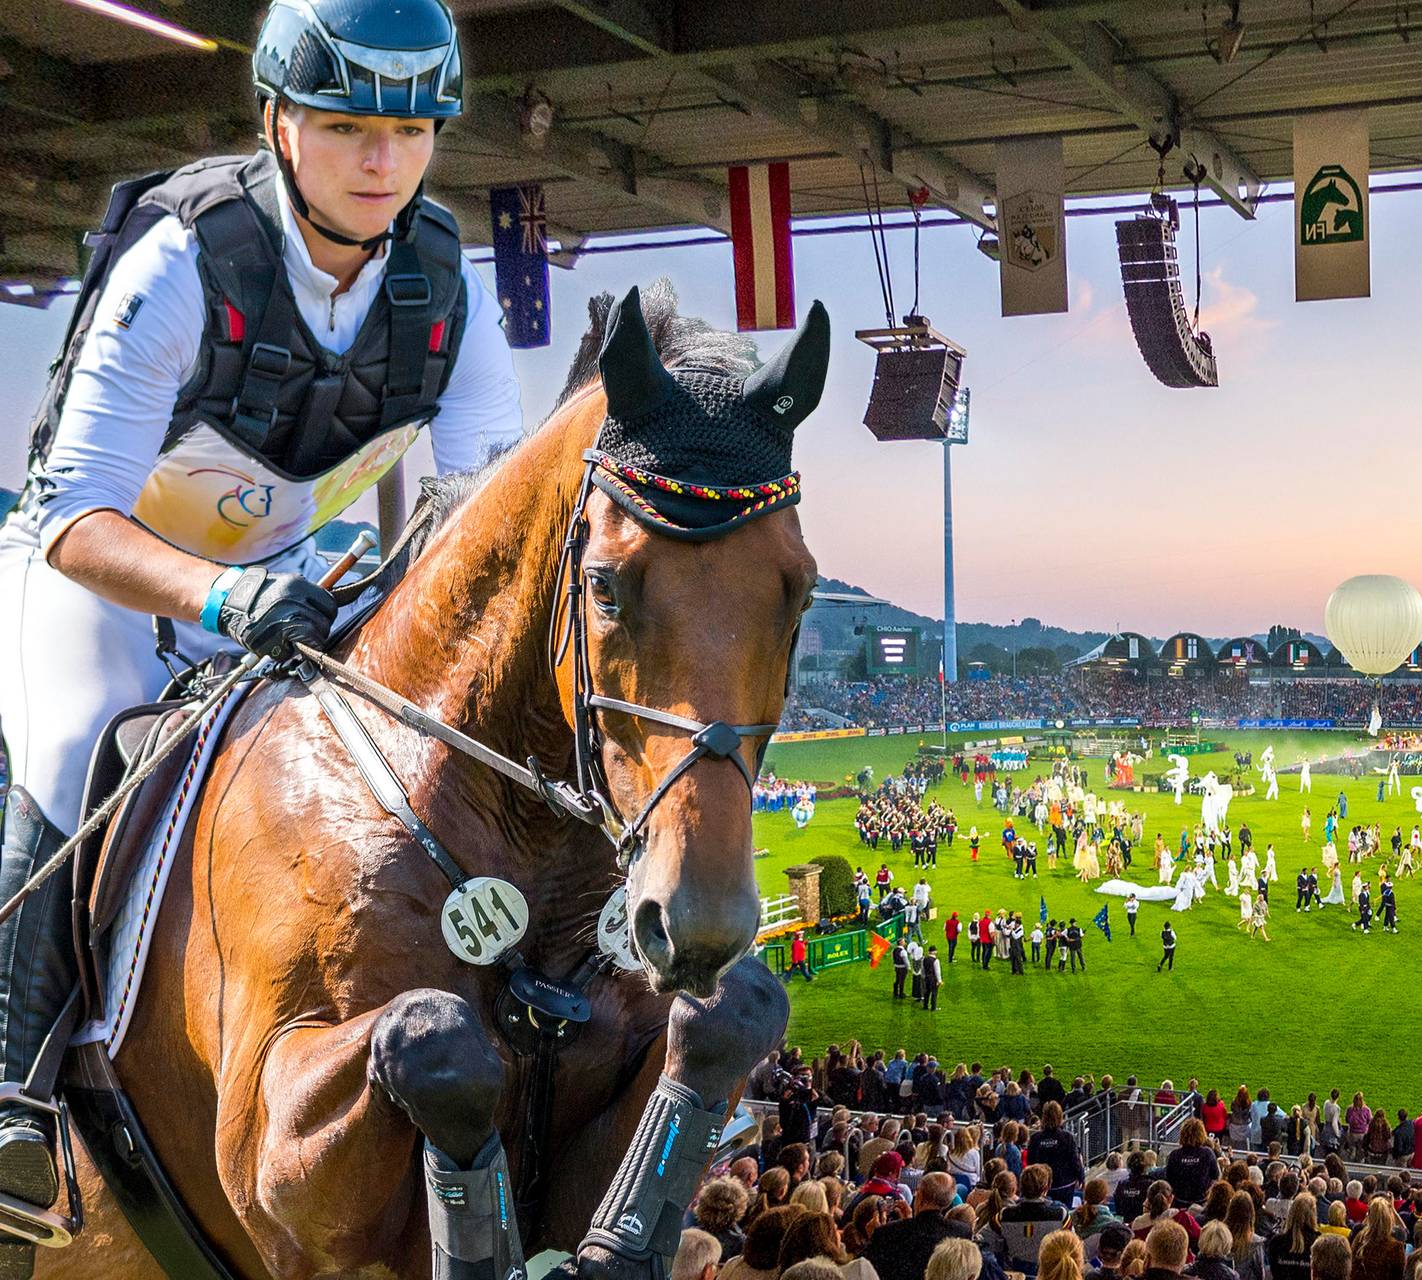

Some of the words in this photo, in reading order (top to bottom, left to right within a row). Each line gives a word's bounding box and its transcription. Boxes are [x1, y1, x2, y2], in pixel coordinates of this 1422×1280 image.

[447, 886, 520, 958] 541
[827, 950, 849, 959] ROLEX
[535, 979, 571, 998] PASSIER
